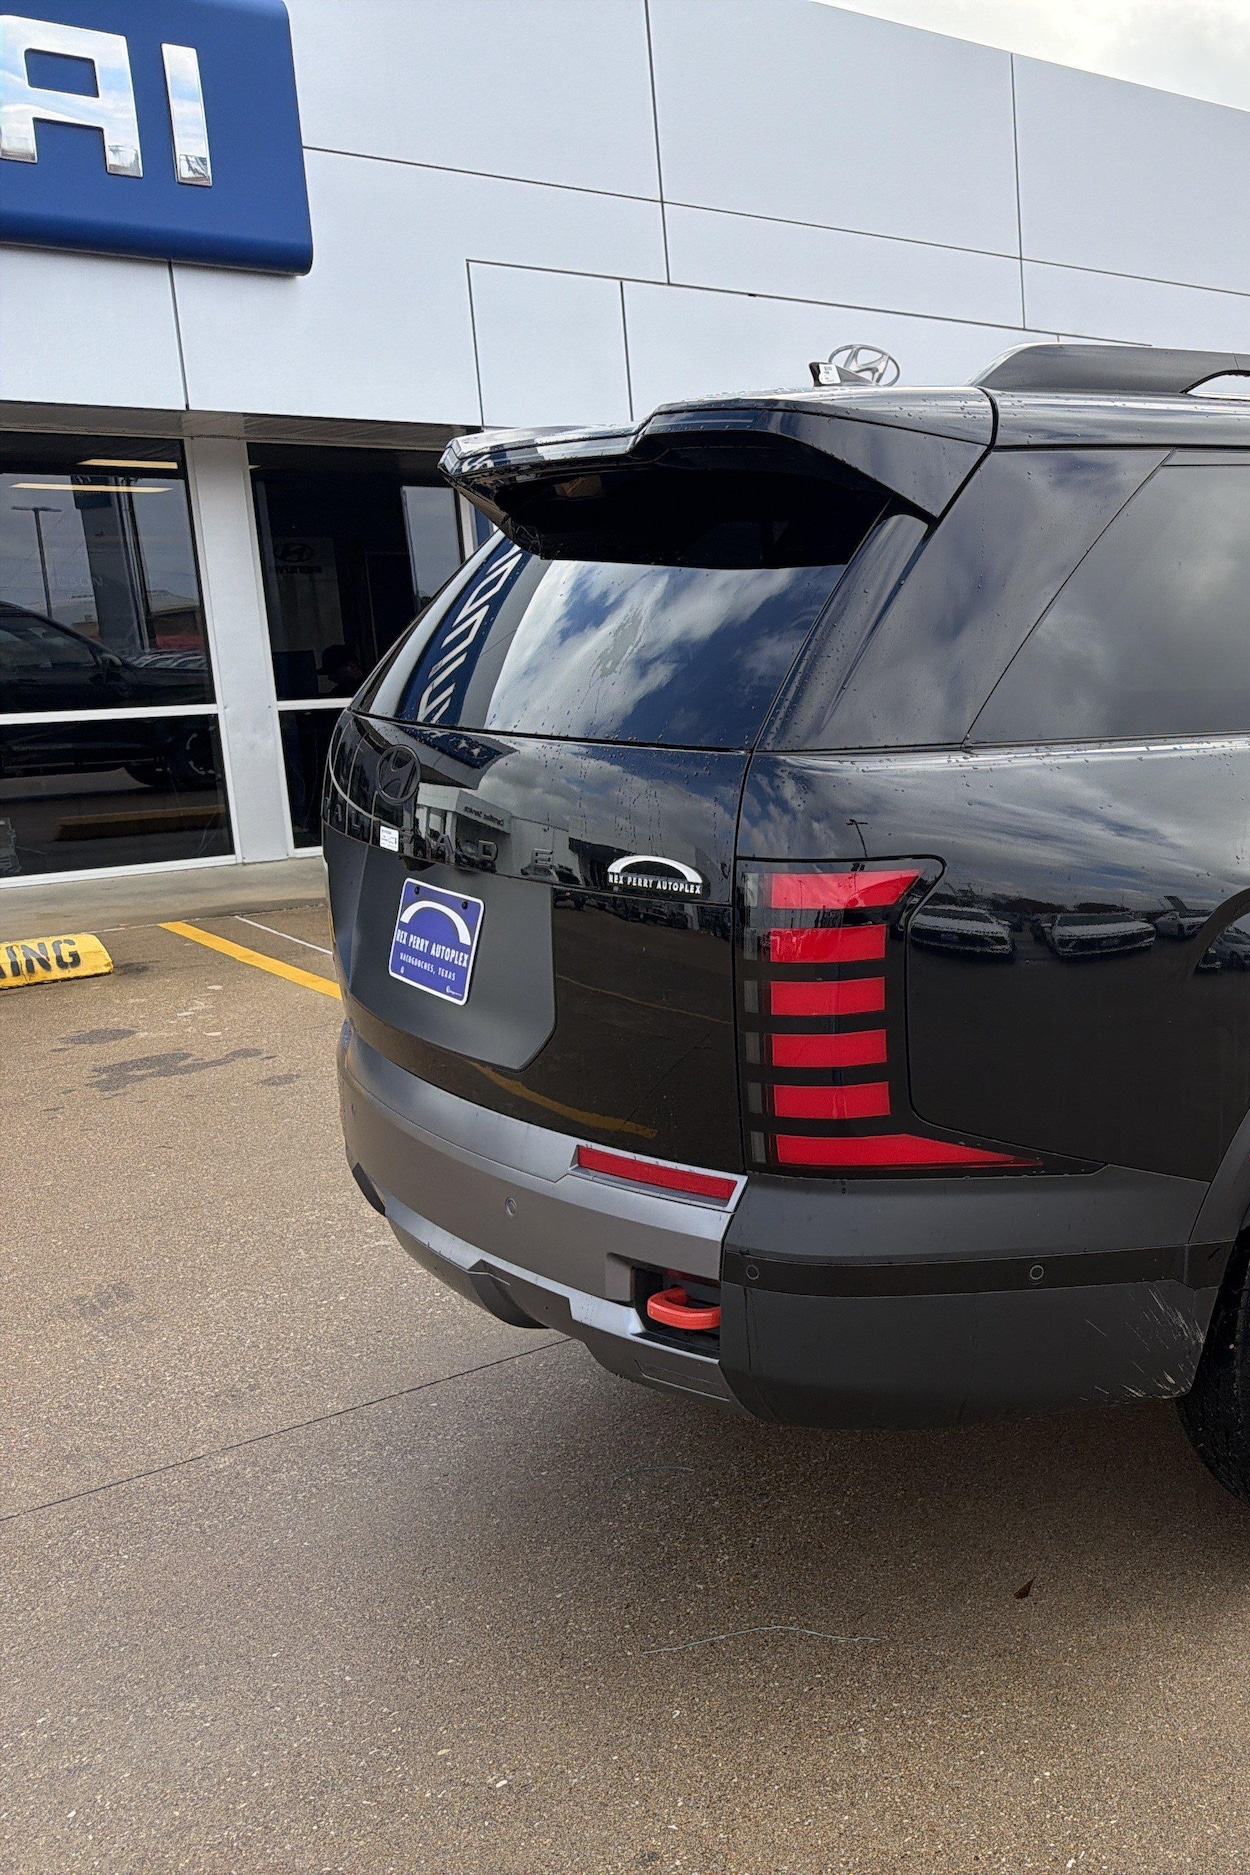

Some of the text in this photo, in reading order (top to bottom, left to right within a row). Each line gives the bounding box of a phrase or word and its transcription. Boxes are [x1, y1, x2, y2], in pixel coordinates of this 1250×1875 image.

[608, 874, 701, 894] REX PERRY AUTOPLEX
[0, 938, 81, 979] ING
[396, 929, 469, 968] REX PERRY AUTOPLEX
[399, 952, 456, 981] NACOGDOCHES, TEXAS
